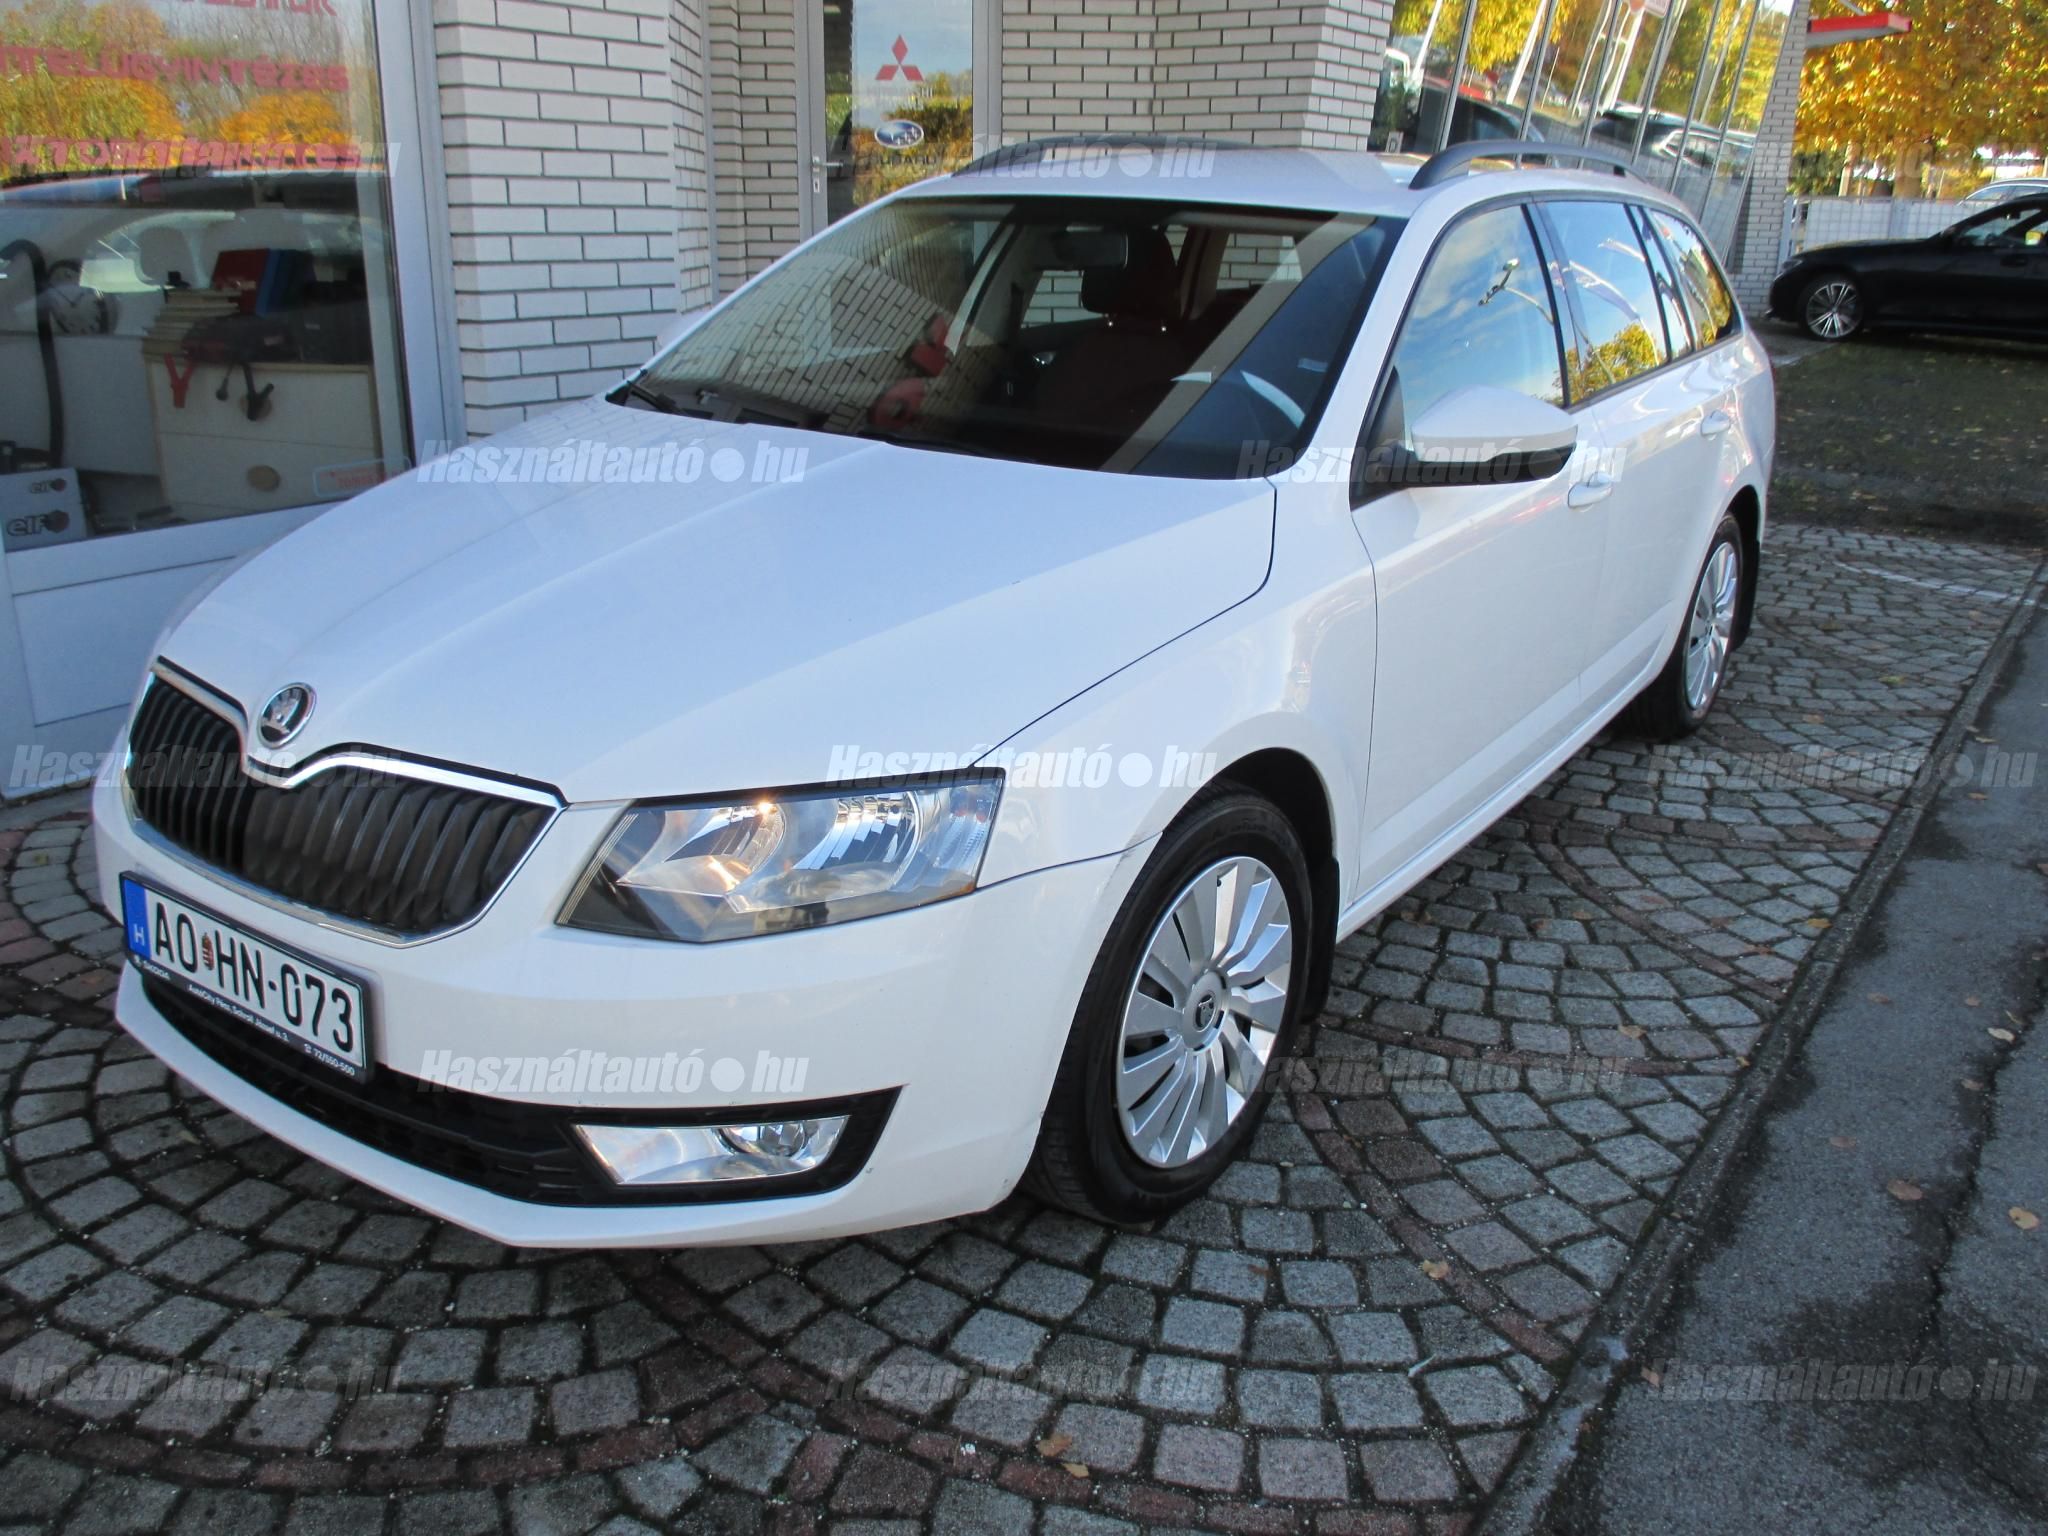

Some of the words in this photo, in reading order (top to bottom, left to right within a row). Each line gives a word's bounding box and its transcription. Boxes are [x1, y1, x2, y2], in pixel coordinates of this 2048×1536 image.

[133, 922, 145, 947] H
[156, 901, 198, 974] AO
[215, 929, 354, 1053] HN-073
